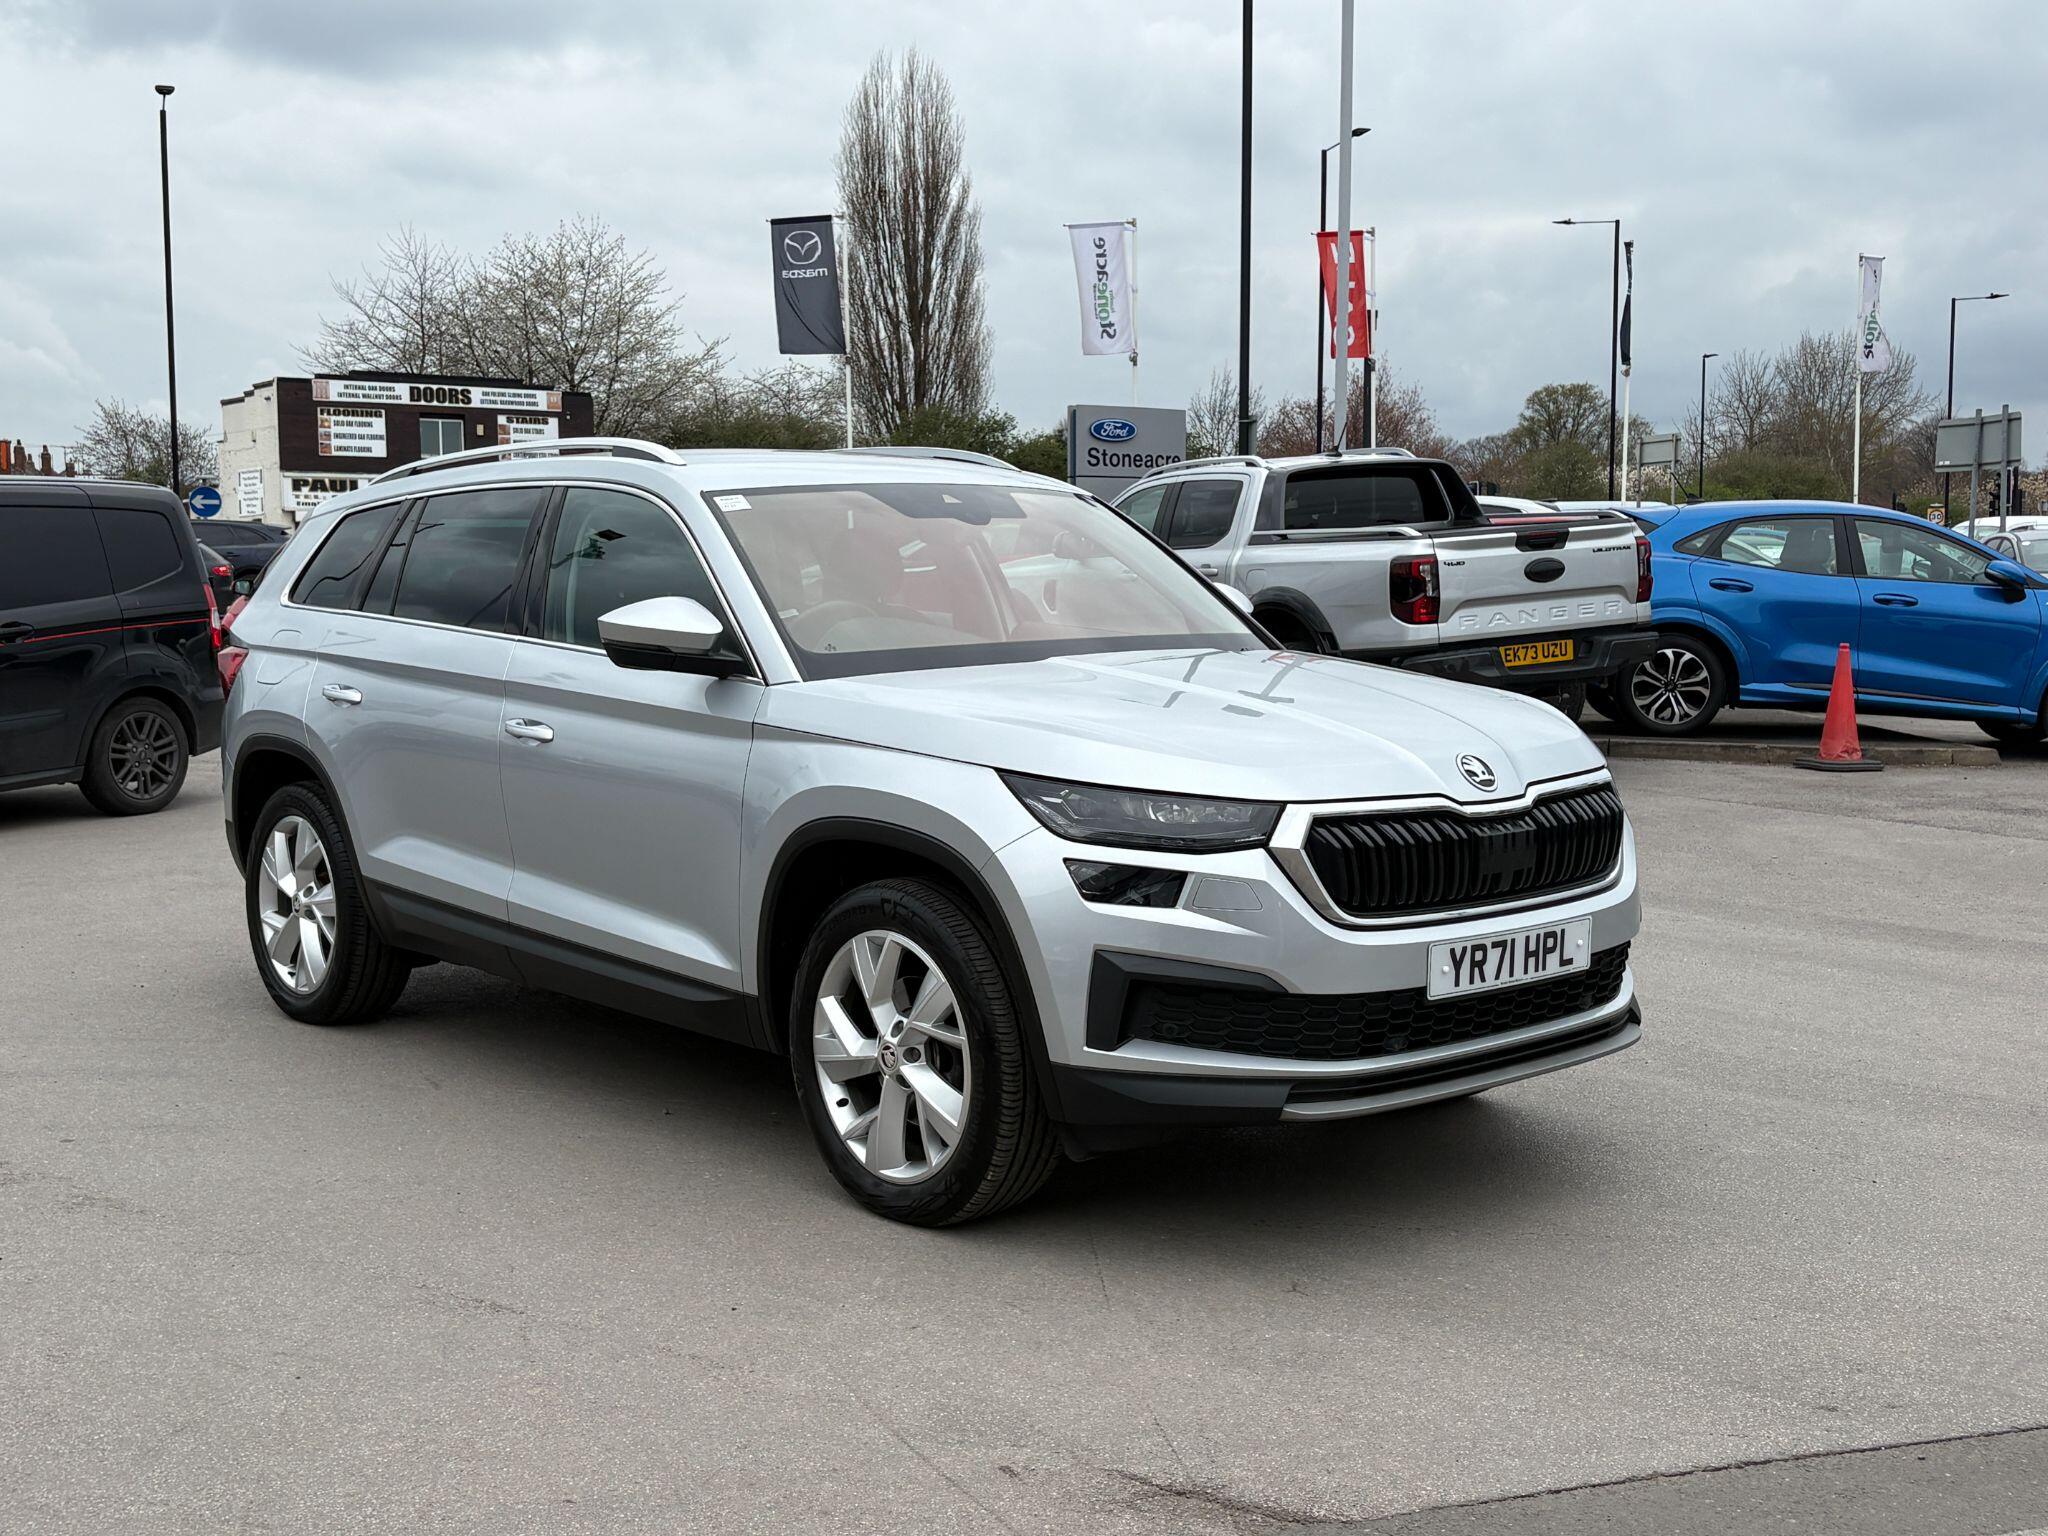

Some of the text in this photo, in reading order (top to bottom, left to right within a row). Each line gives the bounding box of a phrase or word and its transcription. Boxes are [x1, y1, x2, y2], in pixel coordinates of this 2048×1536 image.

[409, 385, 473, 405] DOORS
[320, 408, 383, 418] FLOORING
[506, 416, 549, 425] STAIRS
[1101, 421, 1129, 437] Ford
[1458, 599, 1623, 630] RANGER
[1504, 641, 1568, 663] EK73 UZU
[1450, 928, 1574, 988] YR71 HPL
